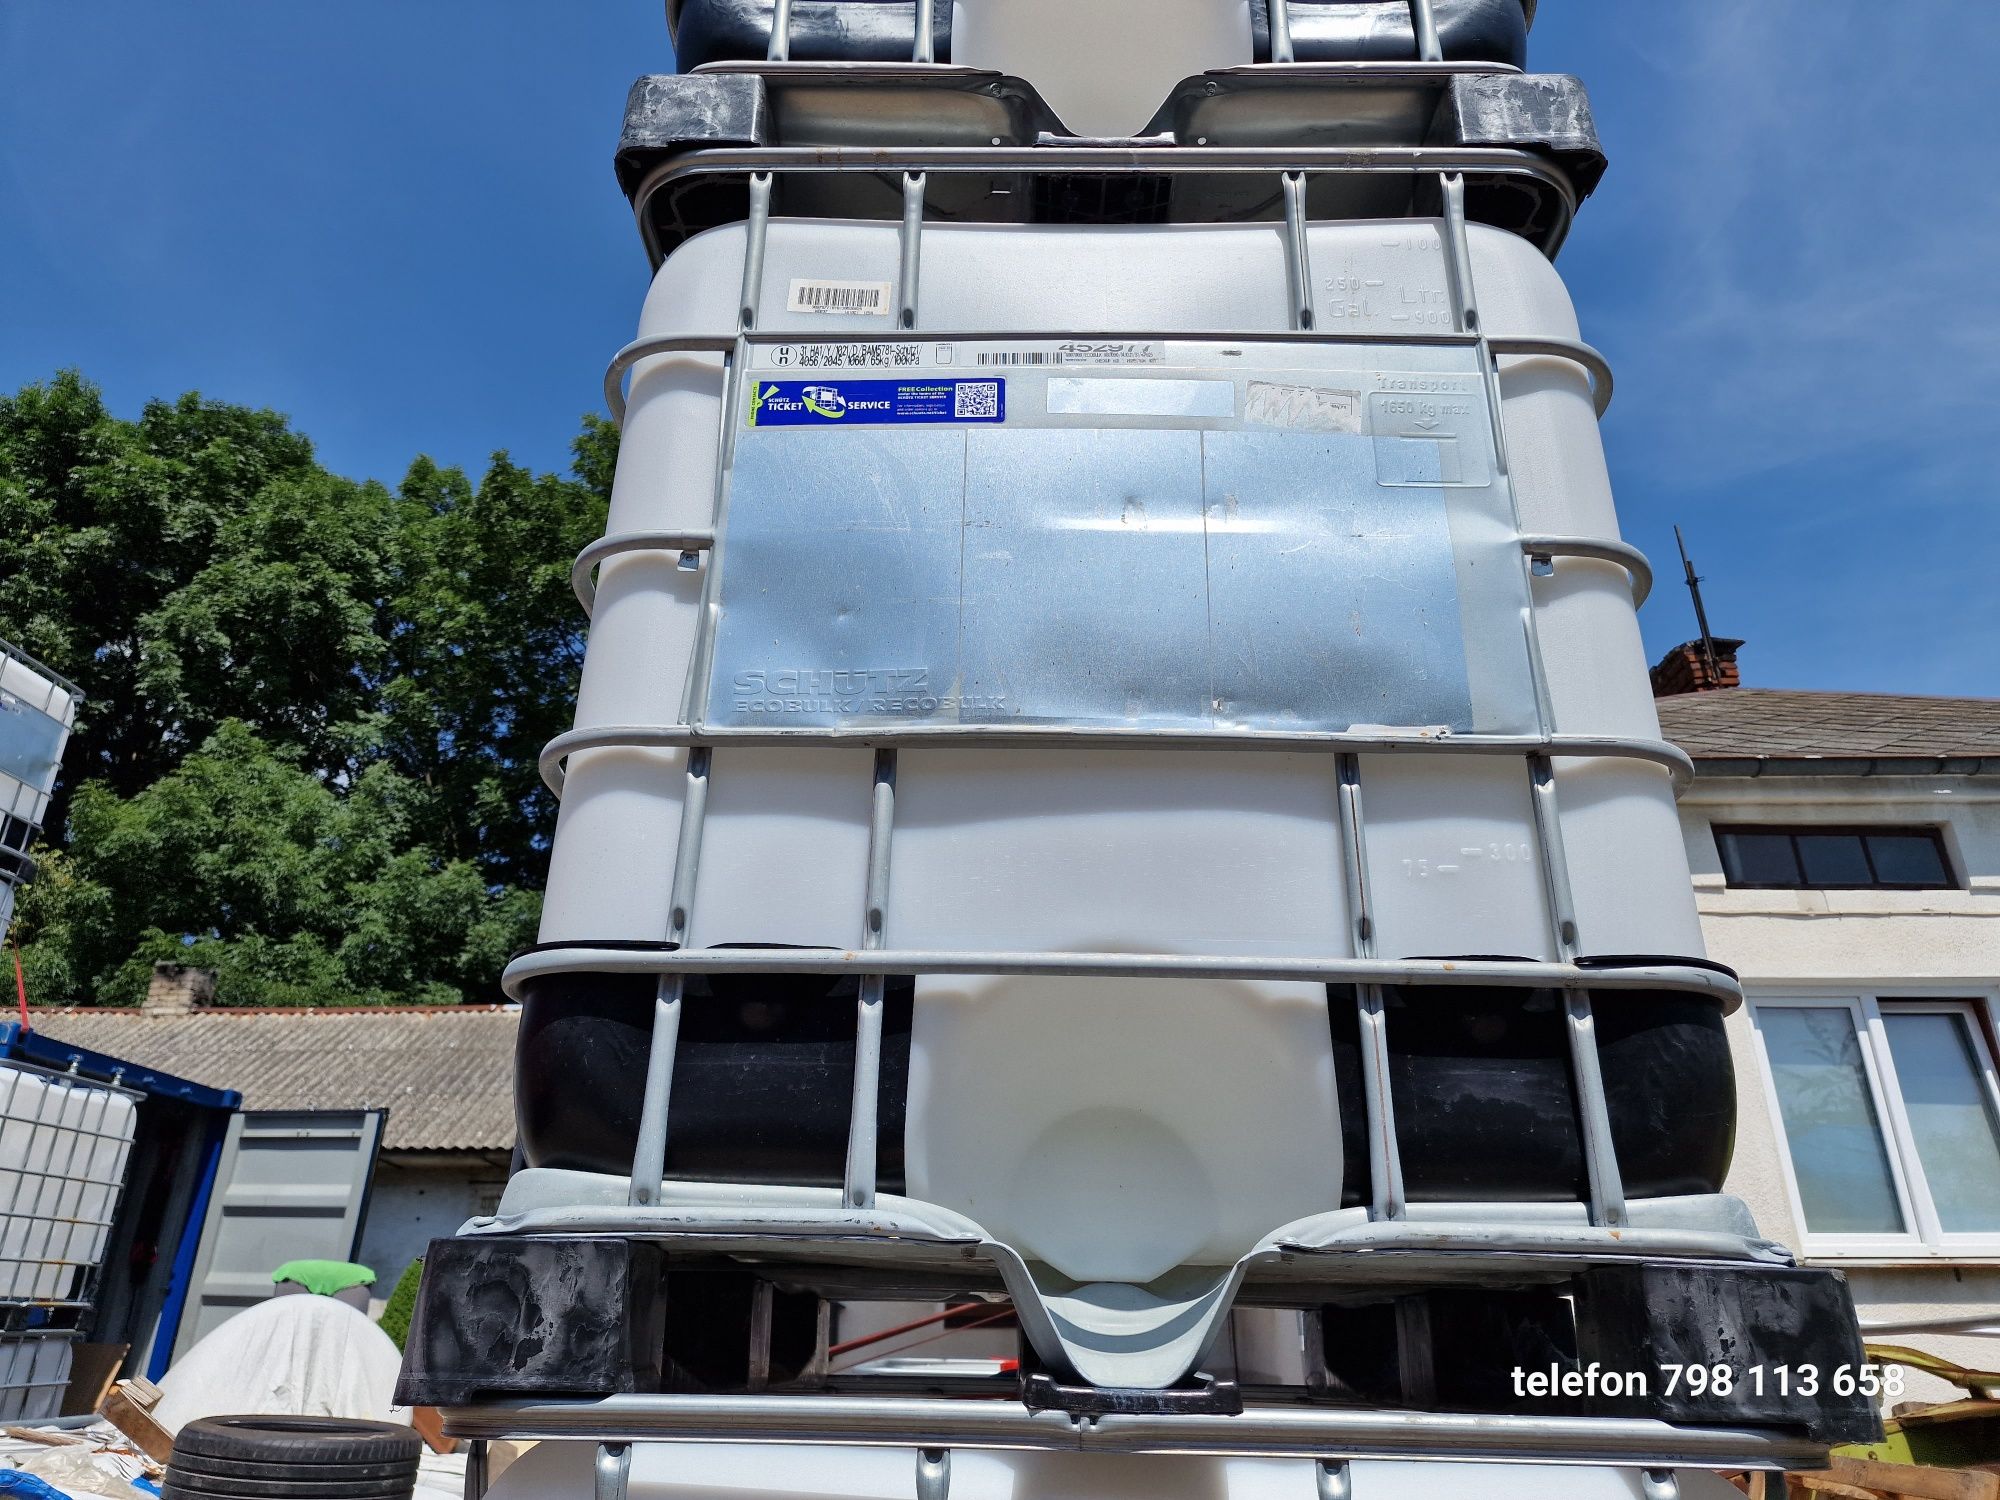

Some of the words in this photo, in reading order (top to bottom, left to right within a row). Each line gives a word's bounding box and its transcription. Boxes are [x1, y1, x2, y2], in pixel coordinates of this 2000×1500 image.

[1325, 277, 1361, 291] 250
[1414, 310, 1451, 324] 900
[1379, 377, 1469, 392] Transport
[767, 402, 804, 411] TICKET
[847, 401, 891, 410] SERVICE
[1380, 400, 1414, 414] 1650
[1419, 401, 1437, 417] kg
[733, 668, 929, 696] SCHÜTZ
[1488, 842, 1534, 863] 300
